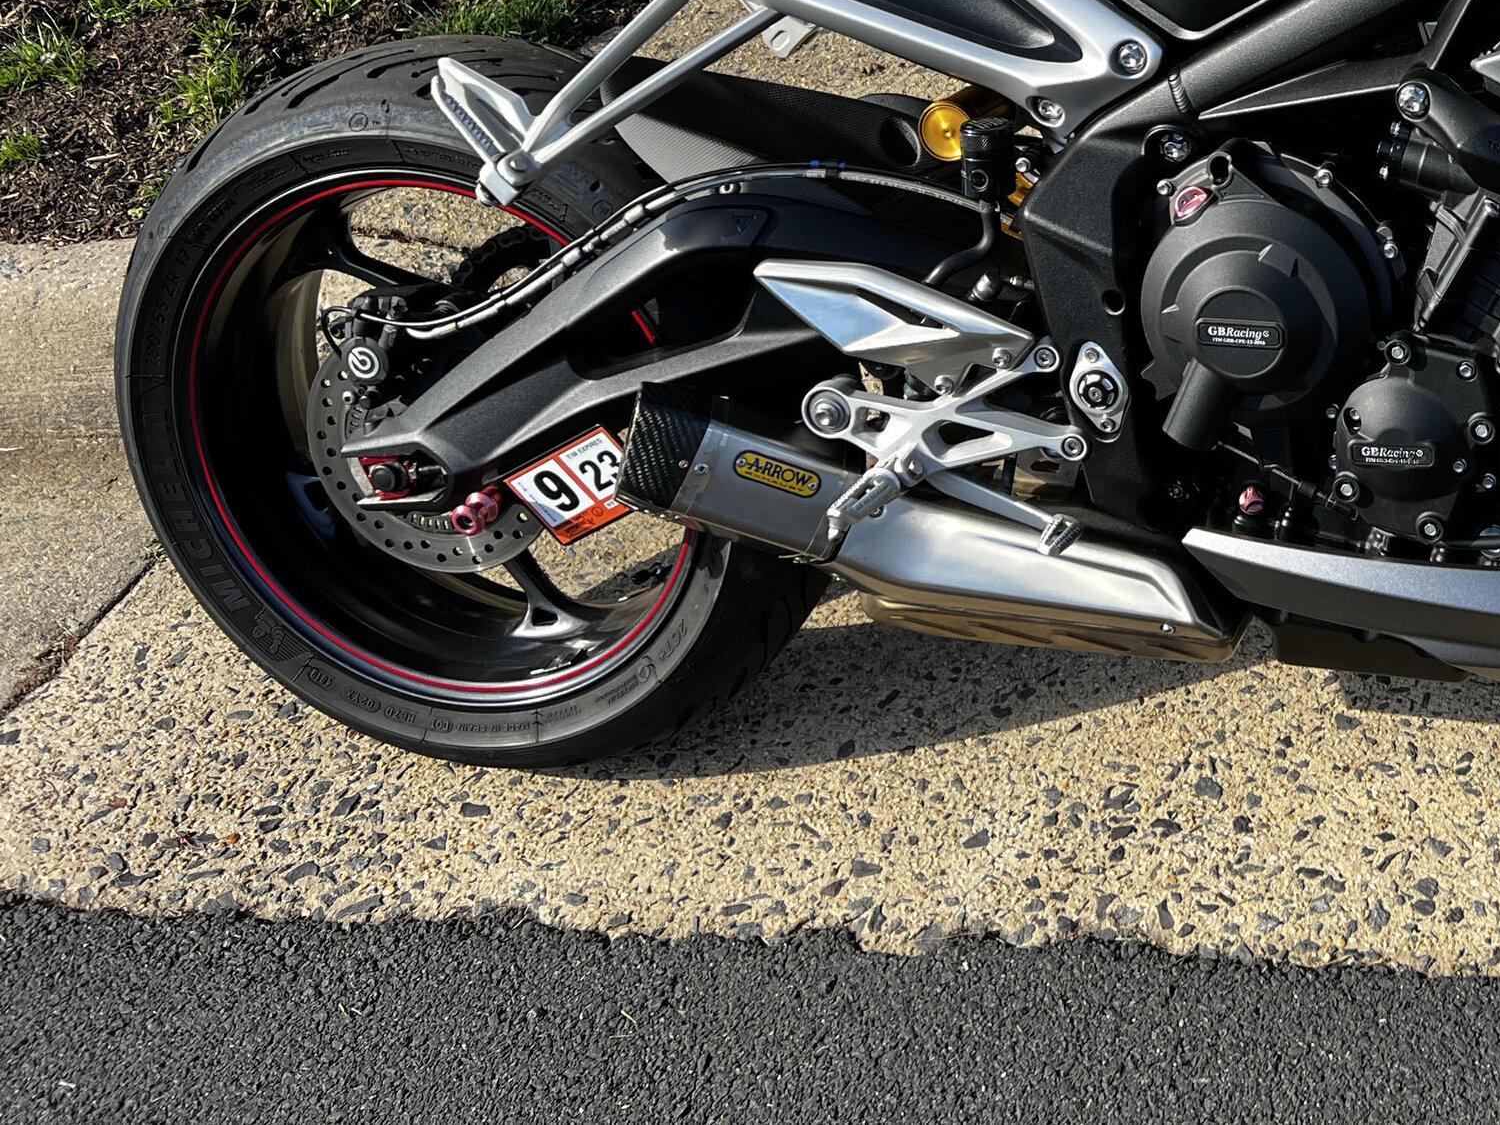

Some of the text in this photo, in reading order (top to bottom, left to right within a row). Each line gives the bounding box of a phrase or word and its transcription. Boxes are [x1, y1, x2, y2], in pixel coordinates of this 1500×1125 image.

[1207, 325, 1262, 341] GBRacing
[747, 457, 813, 487] ARROW
[533, 470, 580, 512] 9
